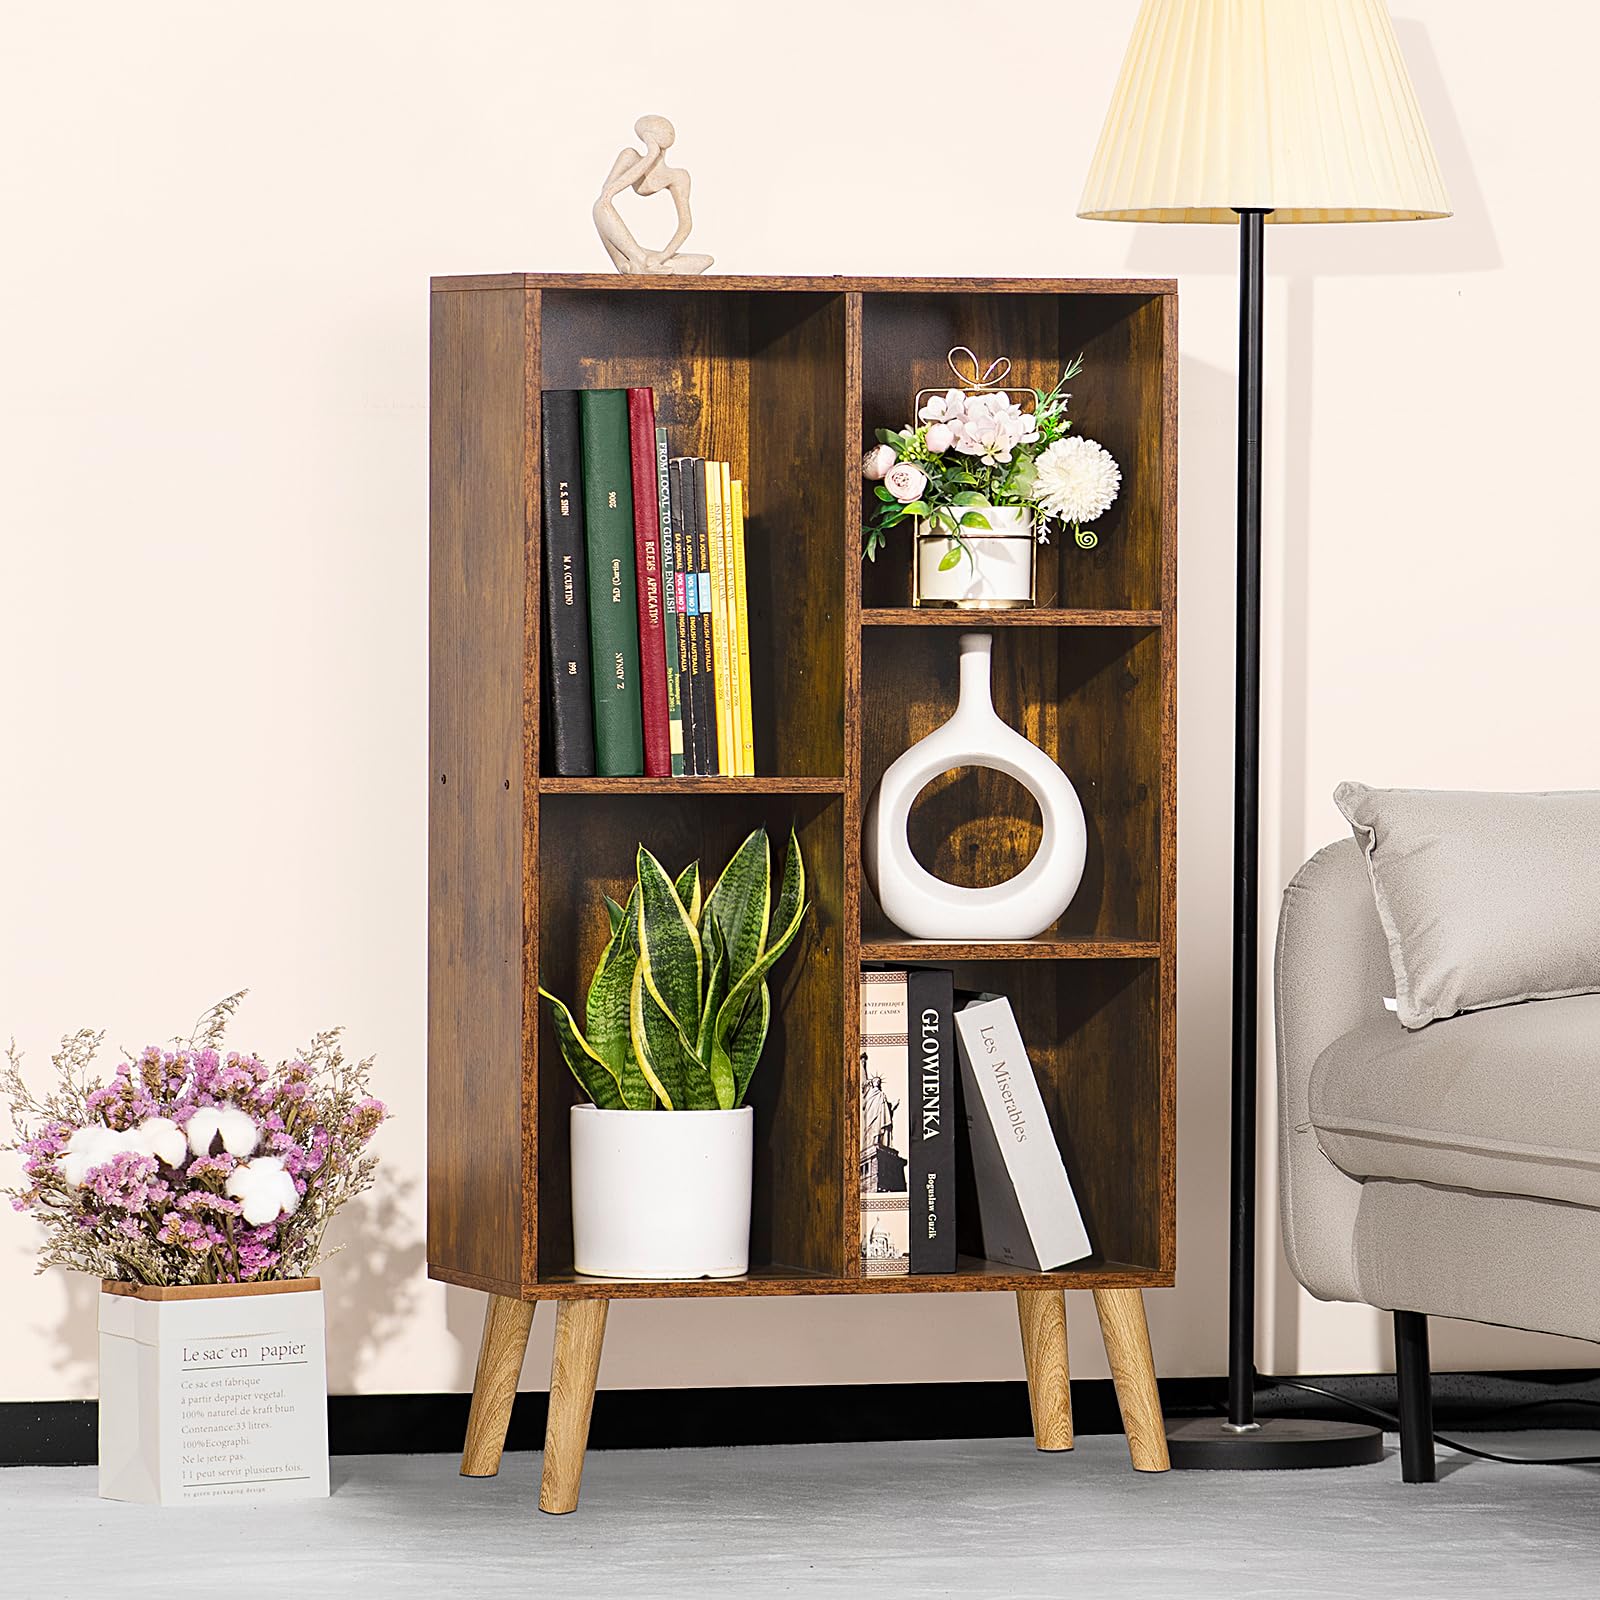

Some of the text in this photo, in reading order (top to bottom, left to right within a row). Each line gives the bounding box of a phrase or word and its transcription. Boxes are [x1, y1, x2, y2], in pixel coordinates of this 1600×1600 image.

[560, 482, 568, 491] K.
[560, 499, 570, 516] SHIN
[608, 491, 616, 509] 2006
[660, 442, 676, 614] FROM LOCAL TO GLOBAL ENGLISH
[675, 534, 681, 542] EA
[685, 535, 692, 544] EA
[699, 533, 706, 543] EA
[563, 555, 571, 563] M
[564, 572, 574, 606] (CURTIN)
[612, 559, 621, 603] PhD (Curtin)
[678, 595, 685, 606] NO
[689, 597, 695, 608] NO
[702, 613, 710, 639] ENGLISH
[689, 616, 698, 676] ENGLISH AUSTRALIA
[703, 638, 711, 673] AUSTRALIA
[615, 652, 624, 680] ADNAN
[921, 1008, 941, 1140] GŁOWIENKA
[980, 1025, 1027, 1143] Les Miserables
[928, 1212, 937, 1240] Guzik
[183, 1341, 306, 1362] Le sac en papier
[181, 1377, 261, 1391] Ce sac est fabrique
[188, 1395, 212, 1407] partir
[182, 1410, 205, 1420] 100%
[252, 1405, 274, 1415] kraft
[182, 1454, 195, 1465] Ne
[196, 1453, 205, 1464] le
[206, 1453, 227, 1464] jetez
[196, 1469, 216, 1481] peut
[218, 1467, 242, 1477] servir
[244, 1465, 282, 1477] plusieurs
